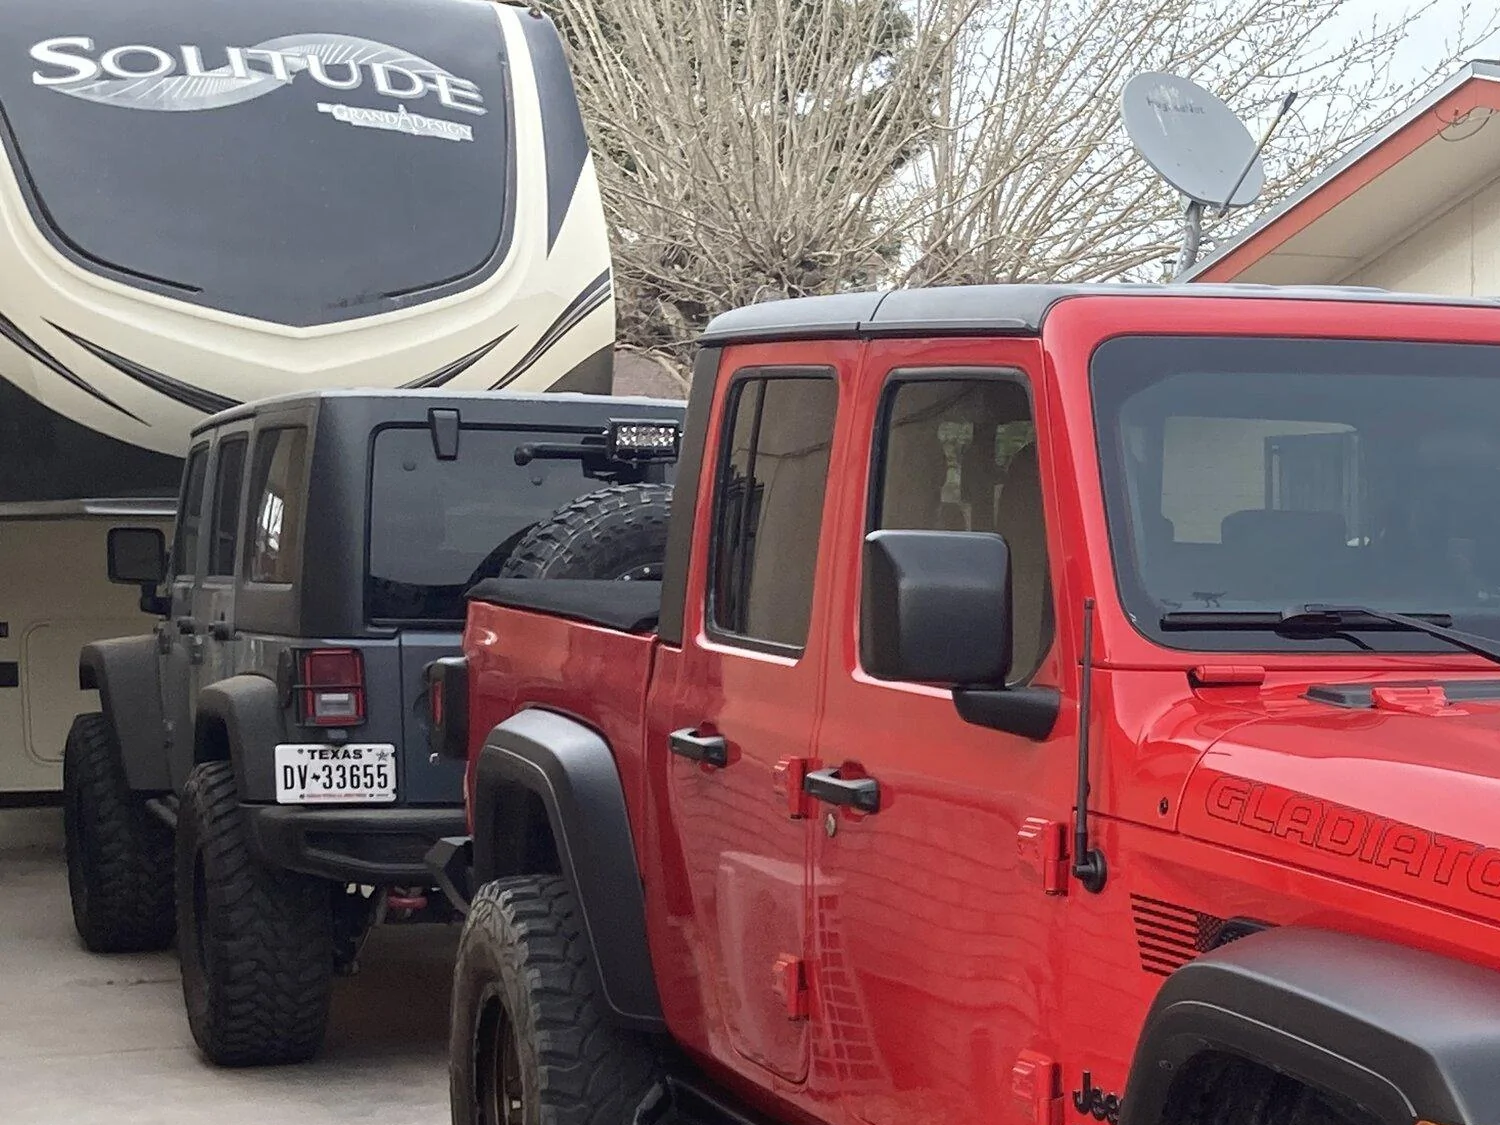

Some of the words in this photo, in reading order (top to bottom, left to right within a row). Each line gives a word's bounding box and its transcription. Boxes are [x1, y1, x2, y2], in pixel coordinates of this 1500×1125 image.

[29, 36, 488, 115] SOLITUDE
[307, 749, 363, 760] TEXAS
[283, 764, 308, 790] DV
[322, 764, 388, 790] 33655
